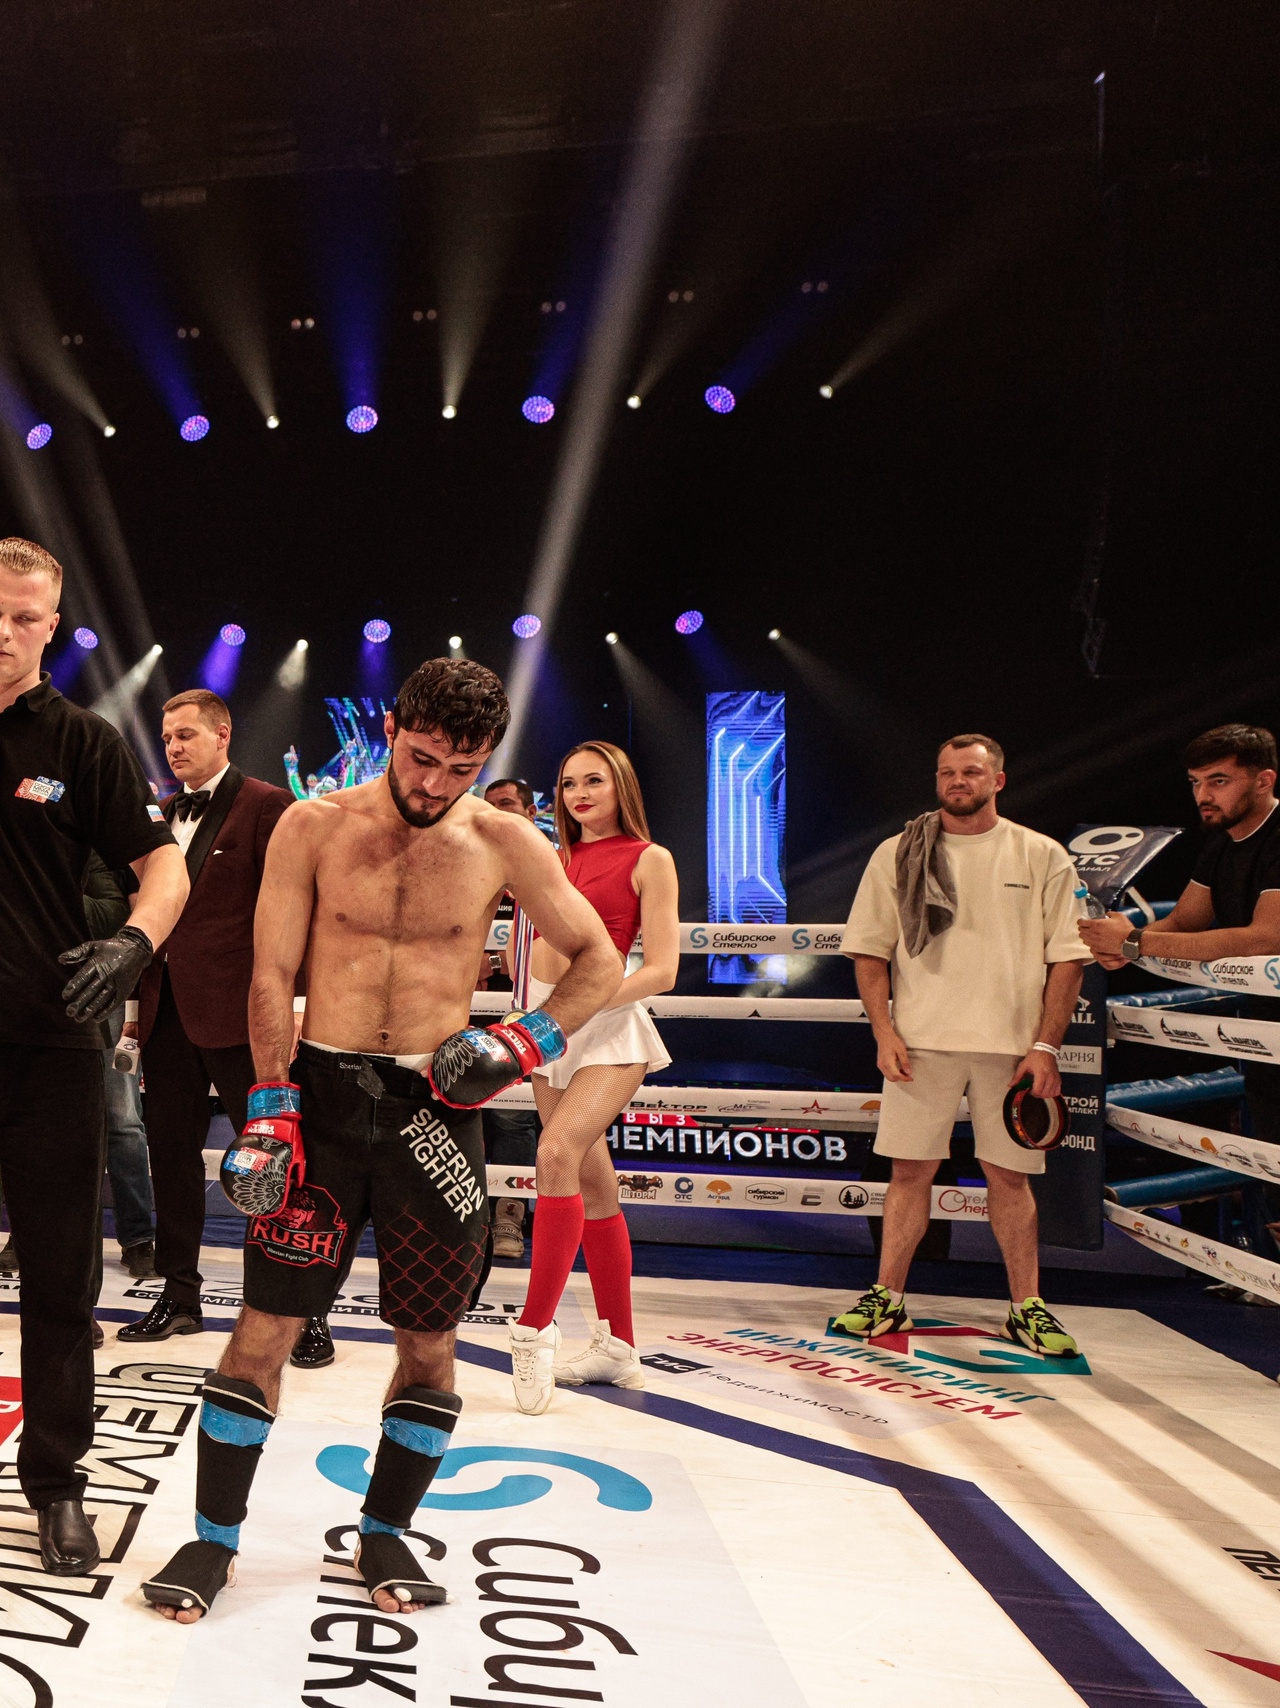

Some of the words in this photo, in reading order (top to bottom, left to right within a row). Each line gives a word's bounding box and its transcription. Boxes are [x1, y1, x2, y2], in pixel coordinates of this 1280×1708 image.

[712, 932, 776, 944] Сибирское
[712, 941, 758, 949] Стекло
[412, 1108, 485, 1212] SIBERIAN
[606, 1124, 848, 1162] ЧЕМПИОНОВ
[399, 1123, 474, 1223] FIGHTER
[620, 1187, 657, 1200] ШТОРМ
[747, 1189, 785, 1197] сибирский
[252, 1217, 335, 1257] RUSH
[266, 1247, 285, 1257] Siberian
[285, 1252, 299, 1261] Fight
[646, 1354, 698, 1374] ГИС
[666, 1332, 1024, 1421] ЭНЕРГОСИСТЕМ
[723, 1328, 1057, 1404] ИНЖИНИРИНГ
[301, 1524, 448, 1708] Стек
[450, 1536, 639, 1708] Сиби
